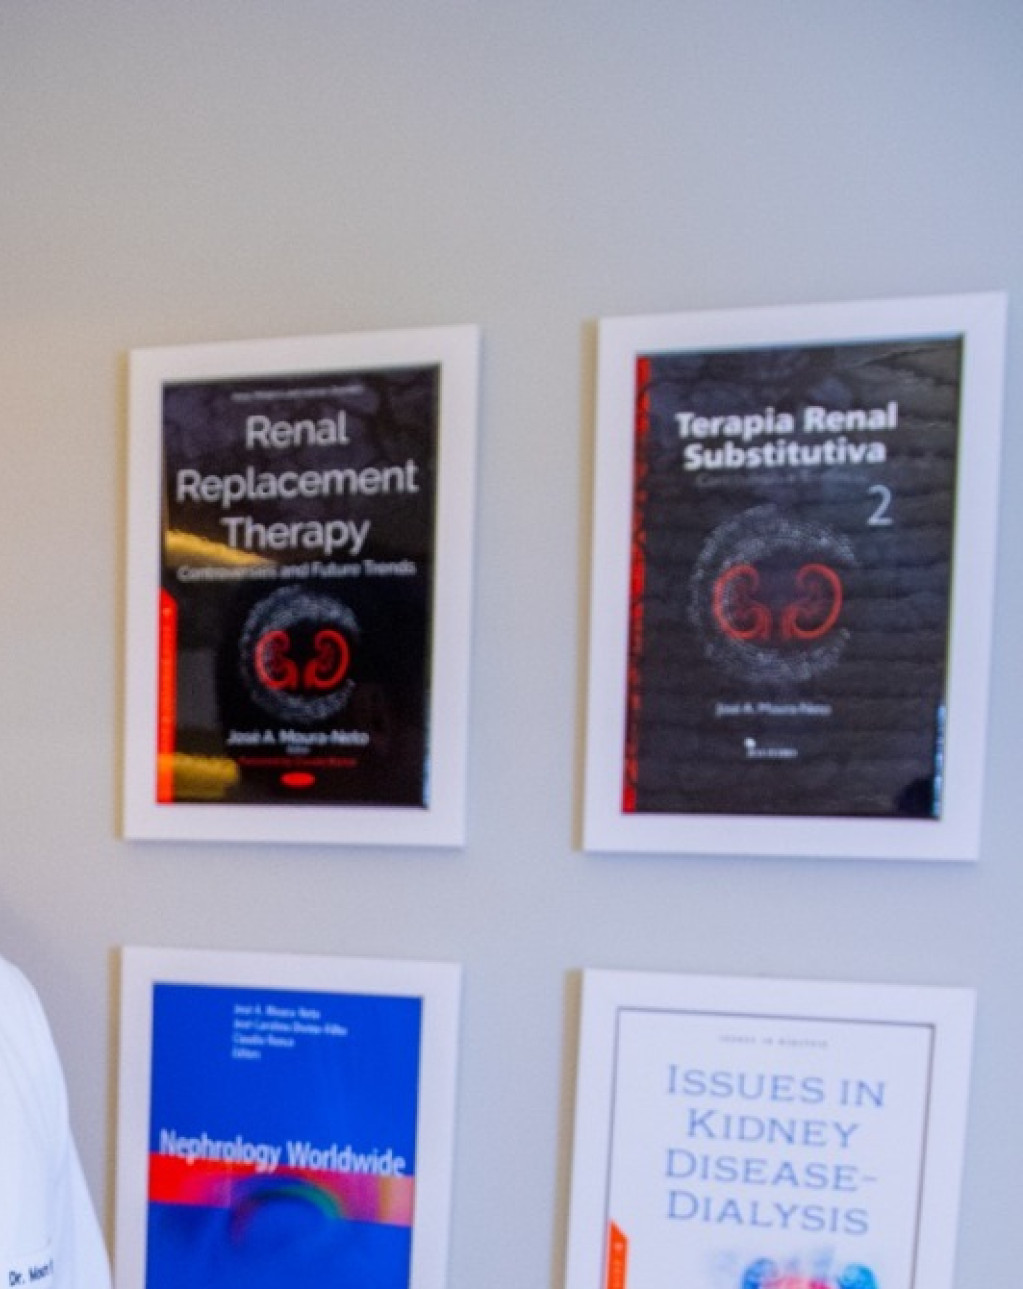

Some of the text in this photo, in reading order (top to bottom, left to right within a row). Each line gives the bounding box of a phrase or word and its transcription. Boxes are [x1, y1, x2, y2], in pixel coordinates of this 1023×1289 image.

[245, 409, 350, 449] Renal
[675, 401, 898, 442] Terapia Renal
[683, 436, 887, 471] Substitutiva
[176, 458, 419, 509] Replacement
[867, 484, 893, 526] 2
[220, 515, 371, 556] Therapy
[279, 562, 310, 578] and
[312, 560, 361, 578] Future
[363, 558, 417, 577] Trends
[668, 1064, 886, 1108] ISSUES IN
[687, 1108, 860, 1148] KIDNEY
[159, 1128, 406, 1175] Nephrology Worldwide
[667, 1190, 870, 1236] DIALYSIS
[9, 1270, 25, 1288] Dr.
